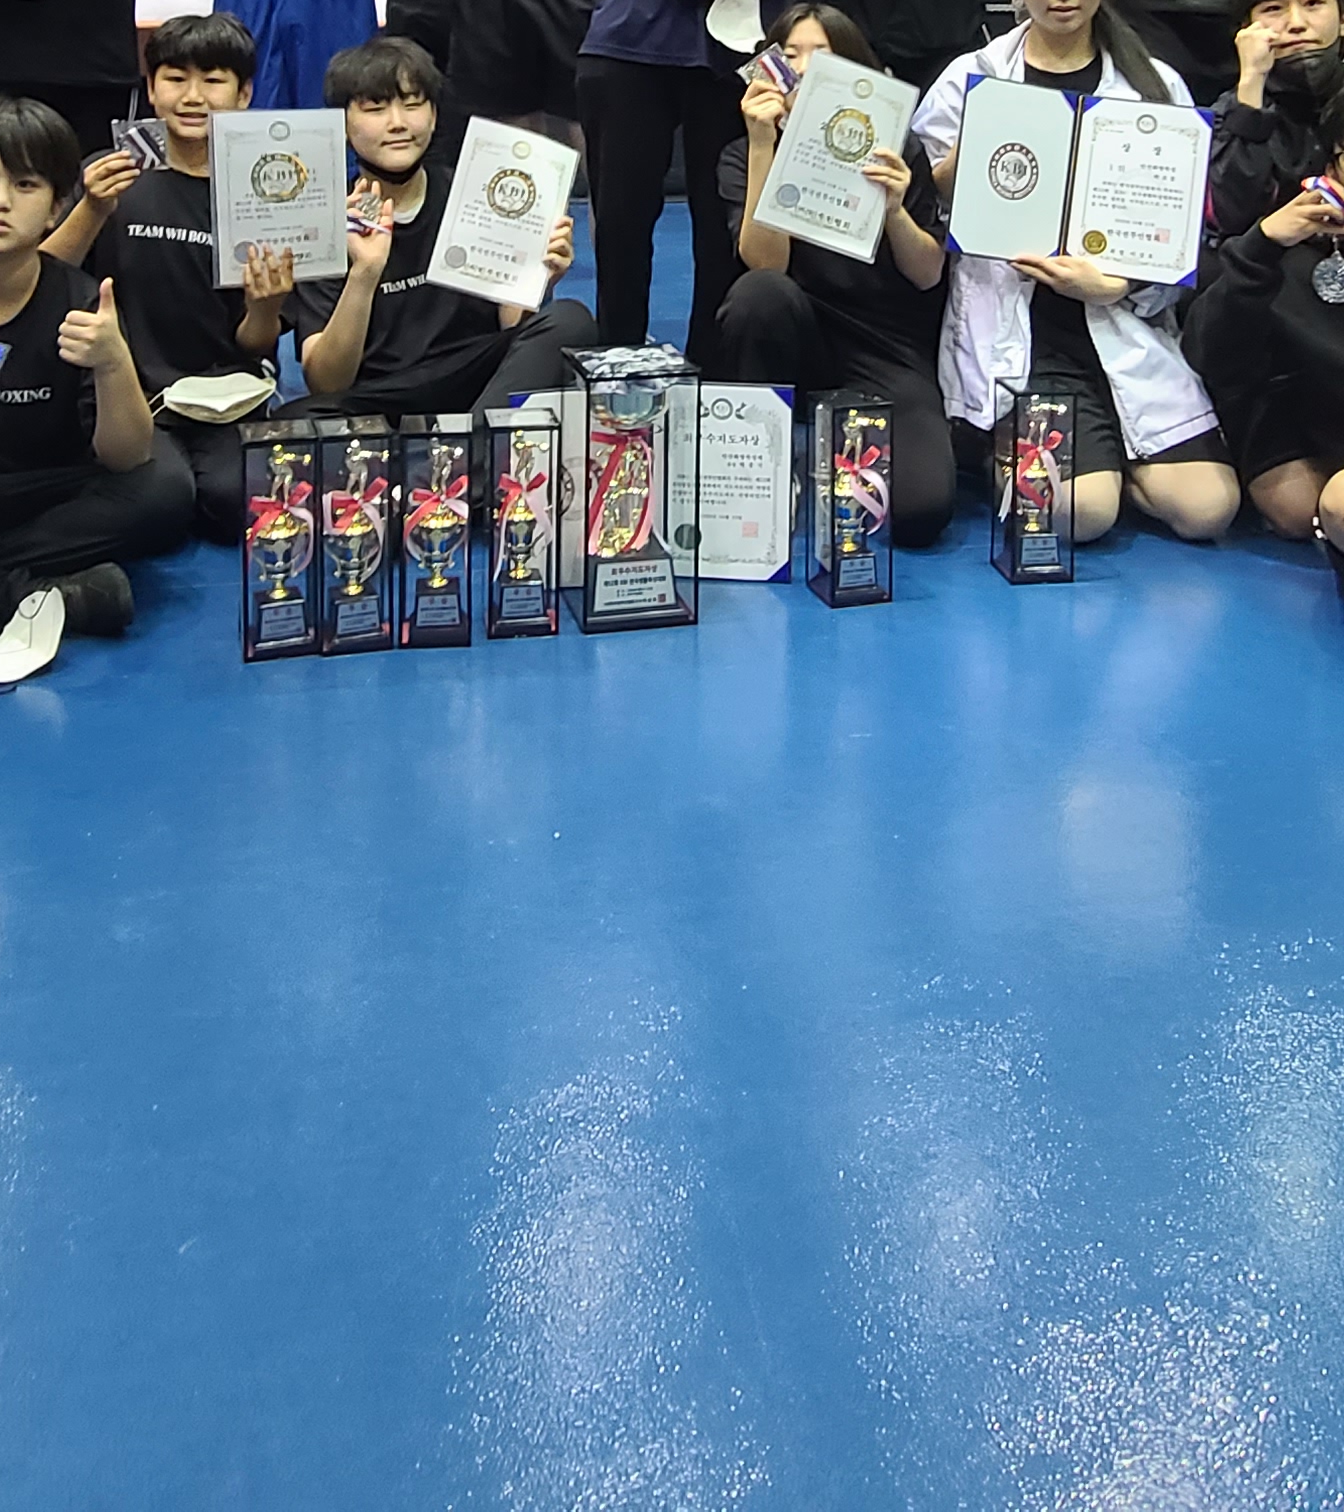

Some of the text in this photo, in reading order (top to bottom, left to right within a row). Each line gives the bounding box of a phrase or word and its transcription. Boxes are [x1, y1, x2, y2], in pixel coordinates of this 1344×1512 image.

[127, 224, 165, 239] TEAM
[188, 230, 213, 246] BOX
[683, 432, 760, 446] 최수지도자상
